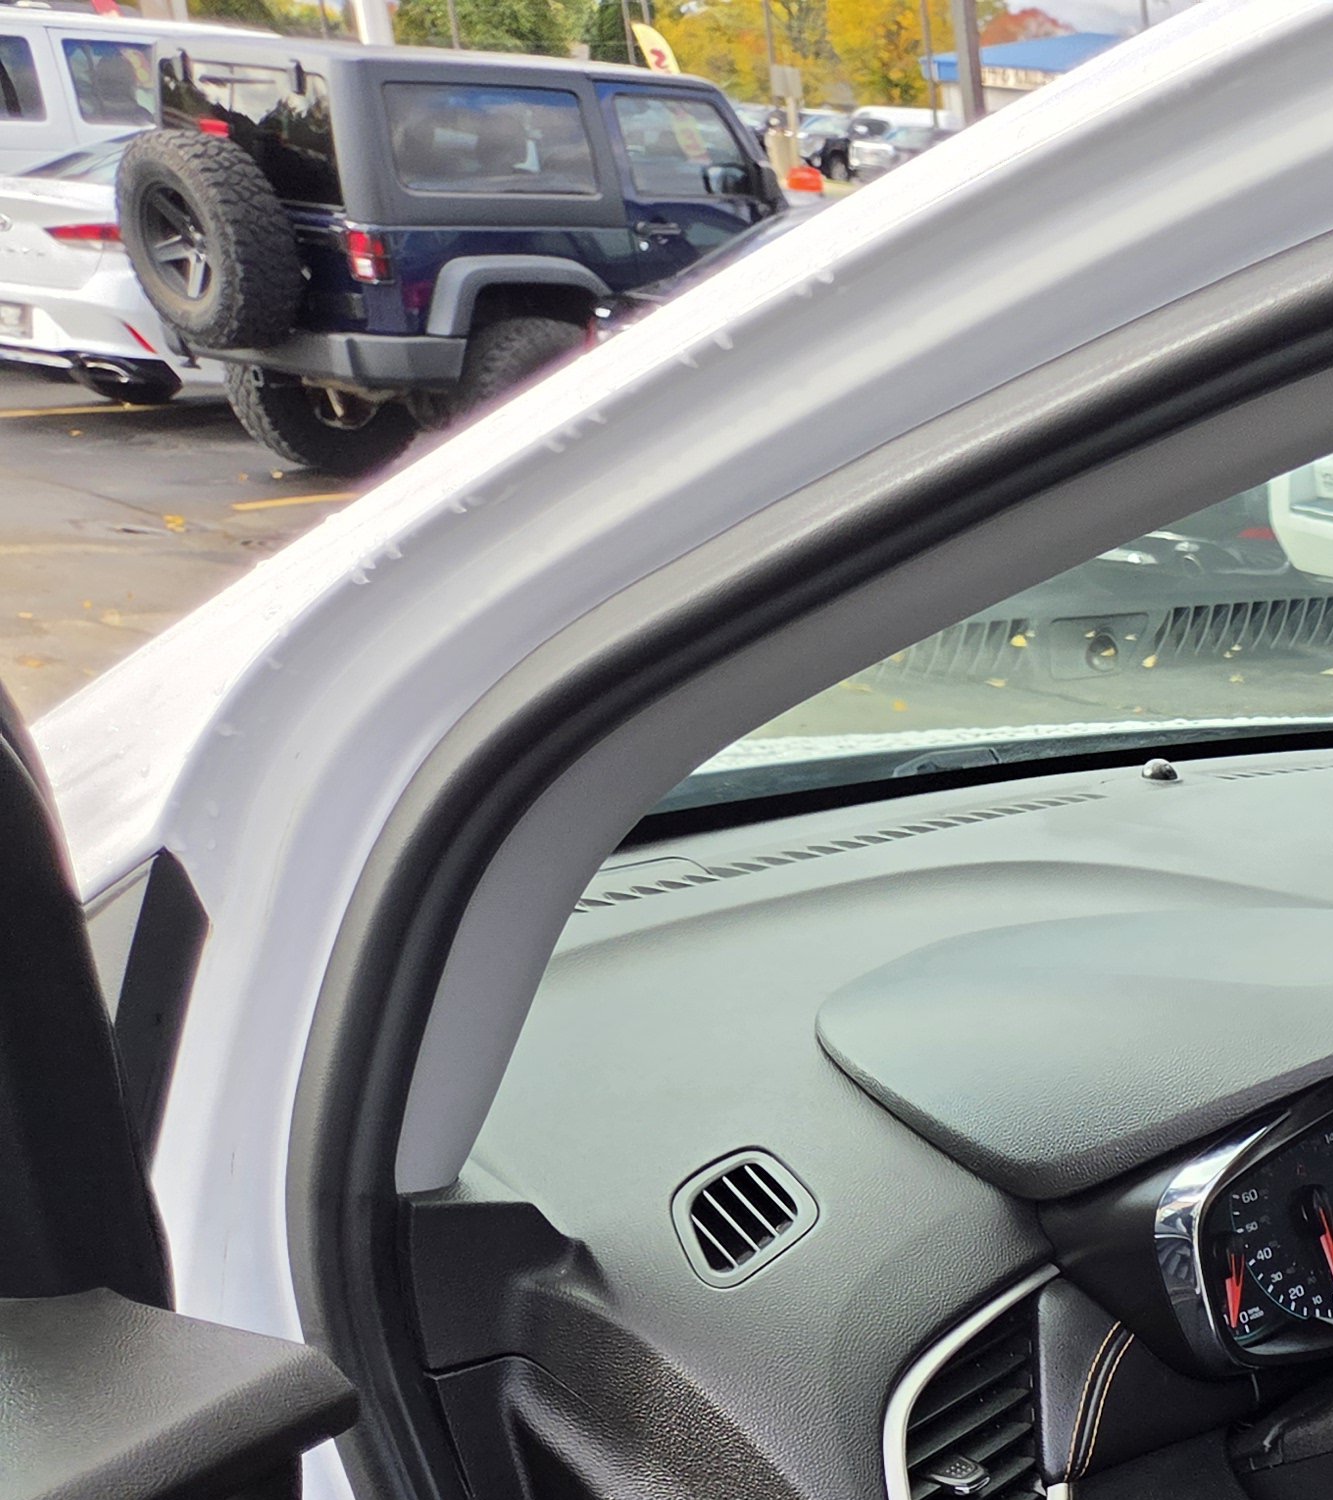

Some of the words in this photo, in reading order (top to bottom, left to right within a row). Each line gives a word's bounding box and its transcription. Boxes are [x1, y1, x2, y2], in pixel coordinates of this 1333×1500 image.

[1241, 1189, 1258, 1204] 60
[1246, 1221, 1258, 1232] 50
[1256, 1247, 1272, 1260] 40
[1271, 1271, 1283, 1283] 30
[1288, 1285, 1305, 1299] 20
[1312, 1295, 1322, 1304] 10
[1239, 1311, 1249, 1324] 0
